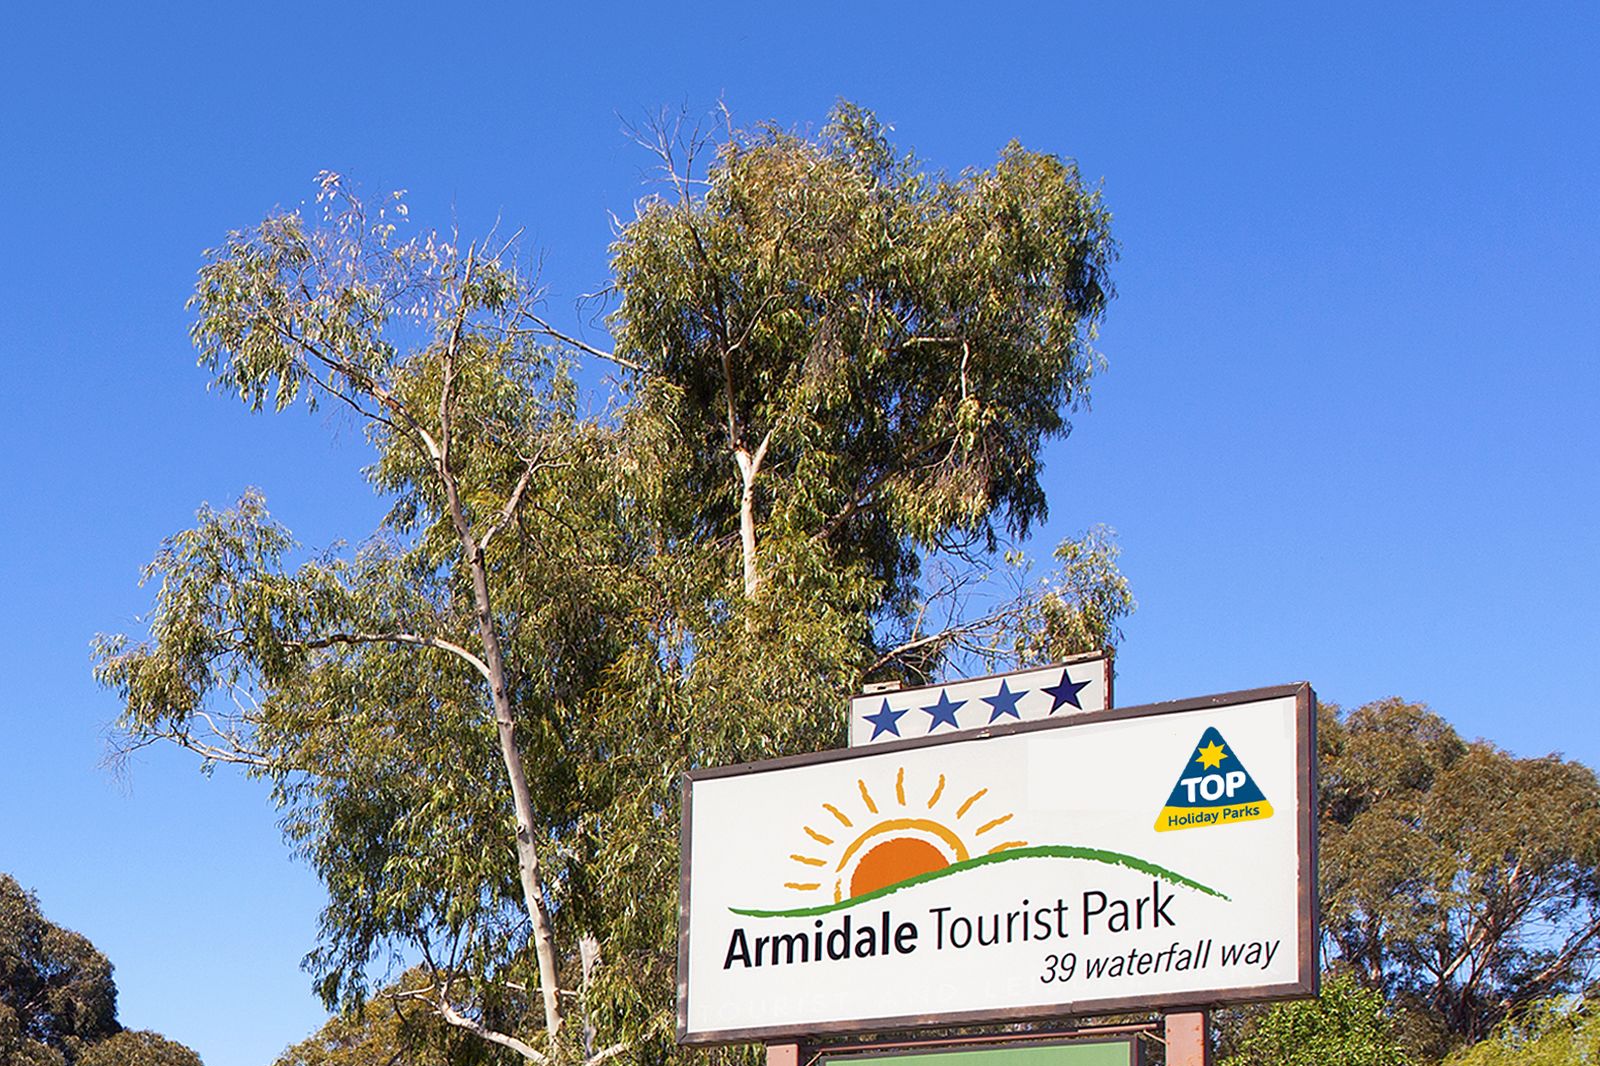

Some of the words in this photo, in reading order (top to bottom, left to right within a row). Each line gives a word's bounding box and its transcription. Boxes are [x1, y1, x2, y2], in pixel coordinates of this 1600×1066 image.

[1180, 770, 1247, 803] TOP
[1168, 811, 1219, 827] Holiday
[1222, 805, 1260, 820] Parks
[723, 910, 918, 970] Armidale
[928, 898, 1069, 950] Tourist
[1083, 880, 1176, 936] Park
[1040, 952, 1077, 984] 39
[1086, 938, 1212, 980] waterfall
[1221, 939, 1281, 970] way
